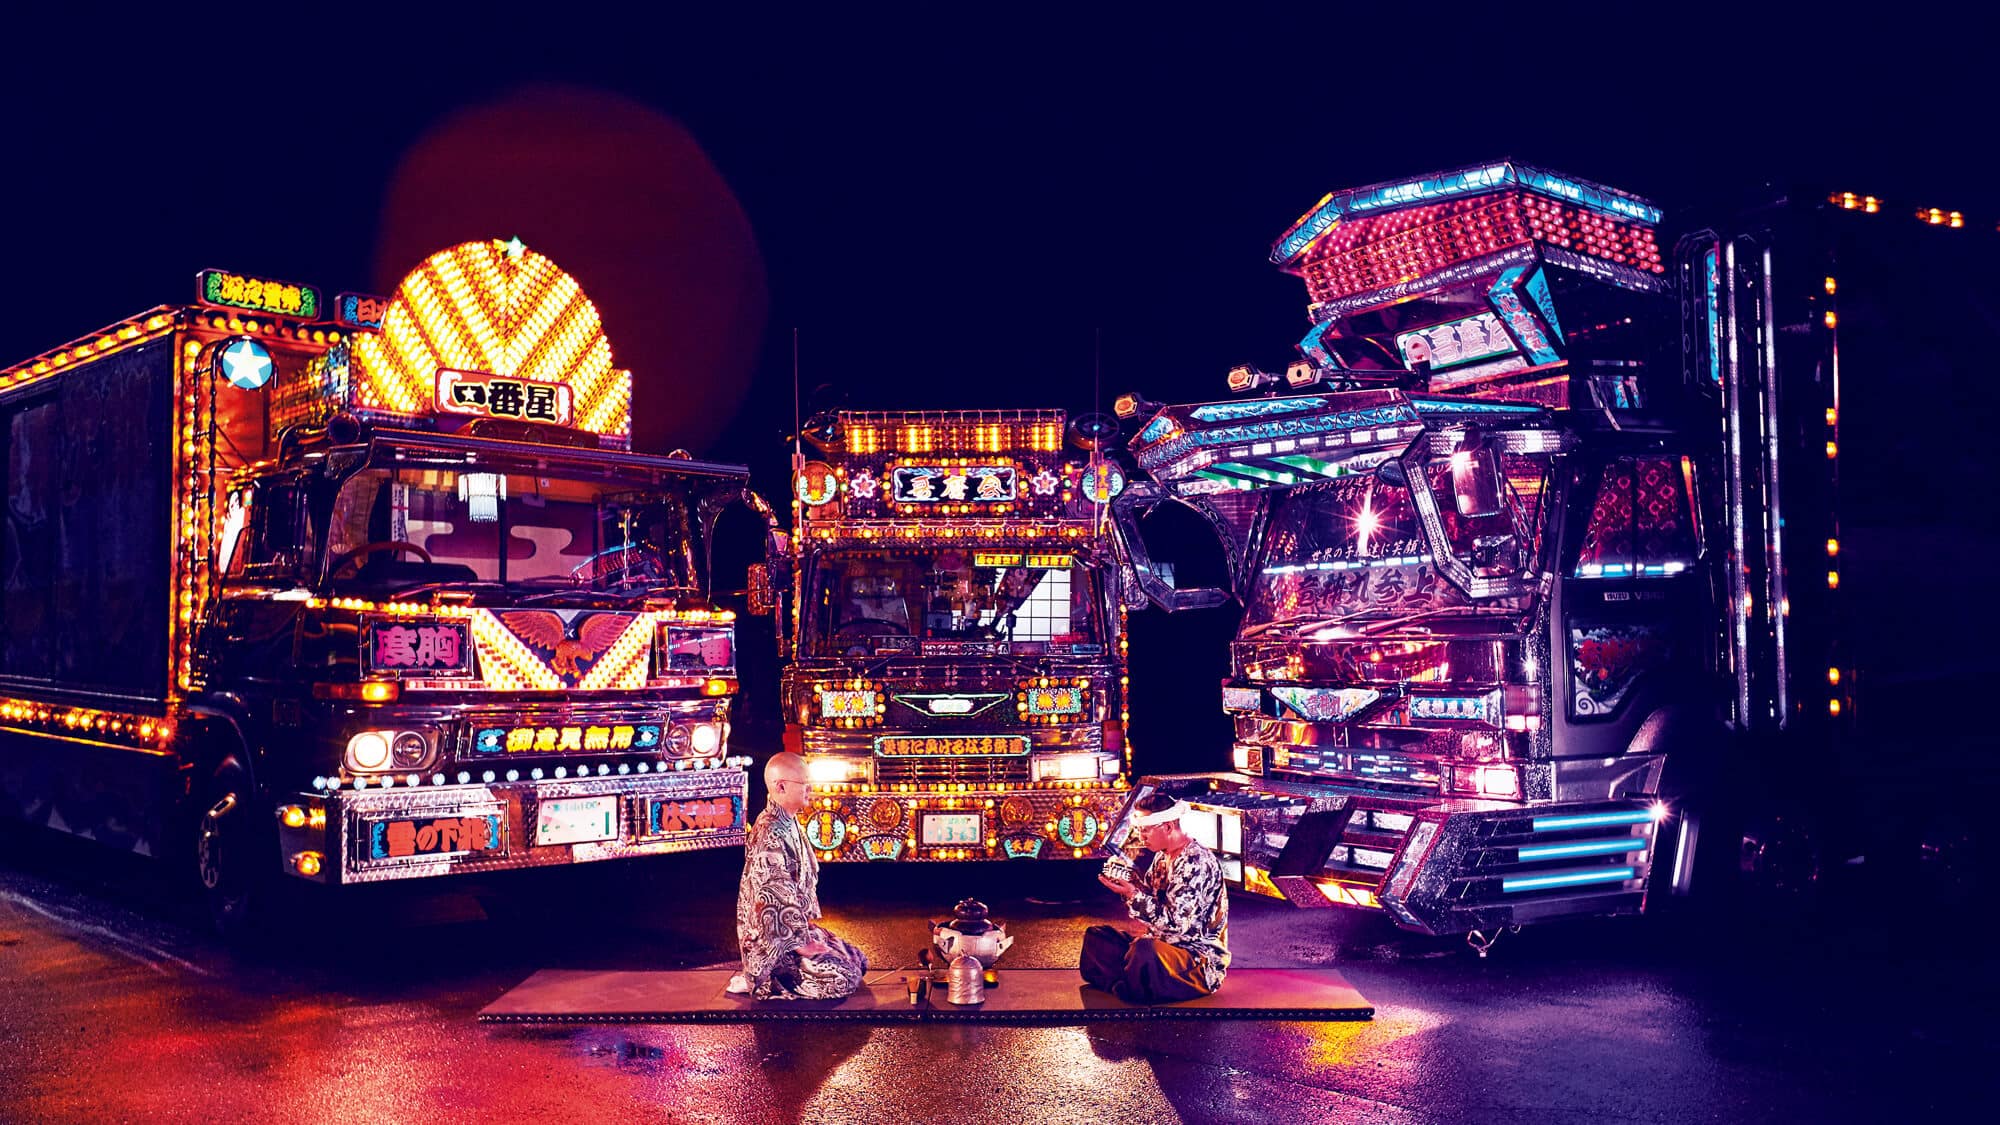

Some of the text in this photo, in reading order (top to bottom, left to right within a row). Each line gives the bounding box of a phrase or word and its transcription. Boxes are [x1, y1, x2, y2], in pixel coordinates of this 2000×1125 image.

[452, 379, 557, 423] 一番星
[376, 625, 461, 667] 度胸
[506, 725, 635, 753] 御意見無用
[387, 818, 485, 857] 雪の下北
